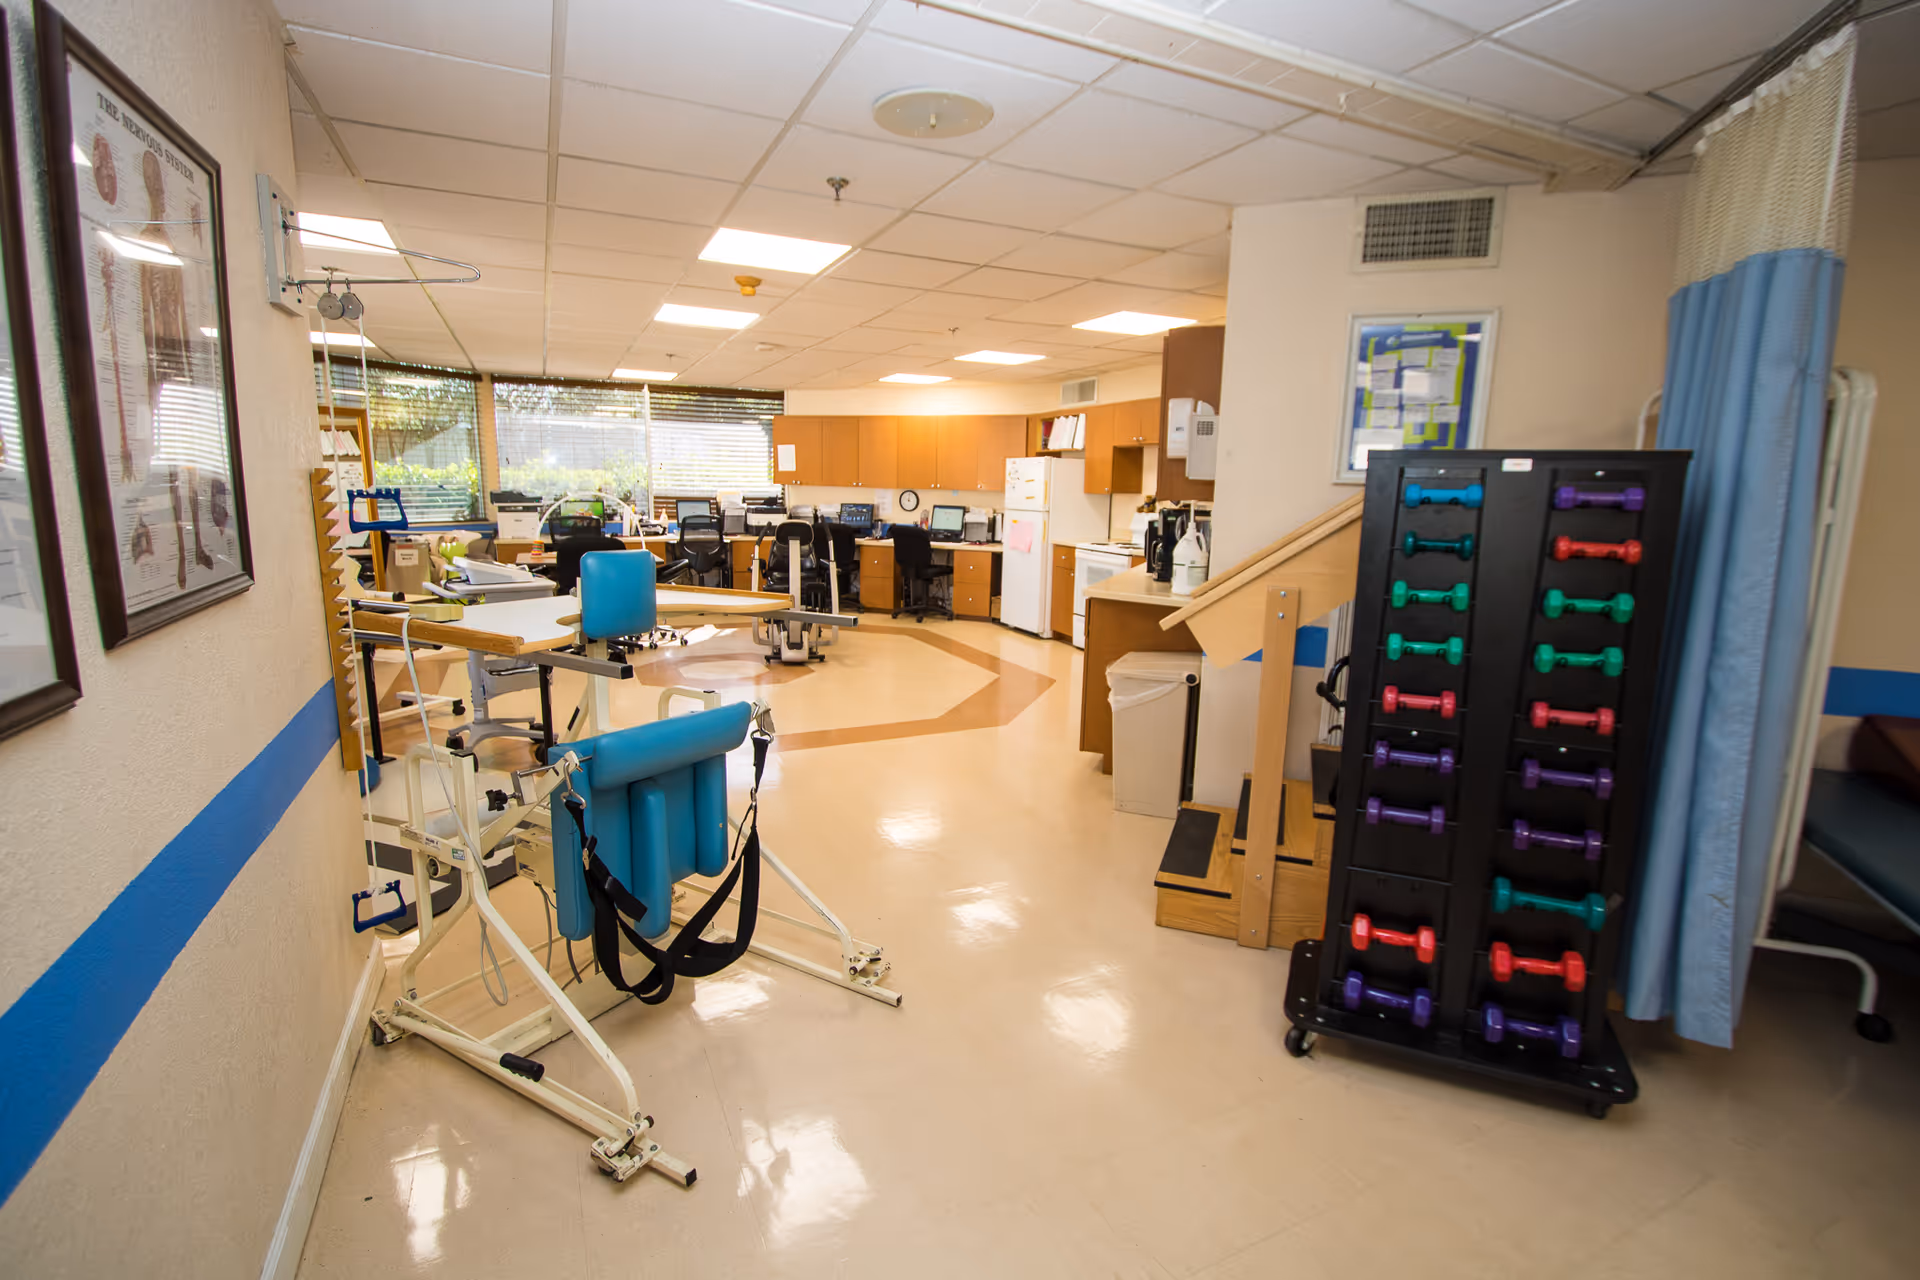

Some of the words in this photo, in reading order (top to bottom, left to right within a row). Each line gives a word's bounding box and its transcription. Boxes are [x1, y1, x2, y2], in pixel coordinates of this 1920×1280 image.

[97, 91, 120, 122] THE
[121, 112, 163, 158] NERVOUS
[164, 149, 194, 184] SYSTEM
